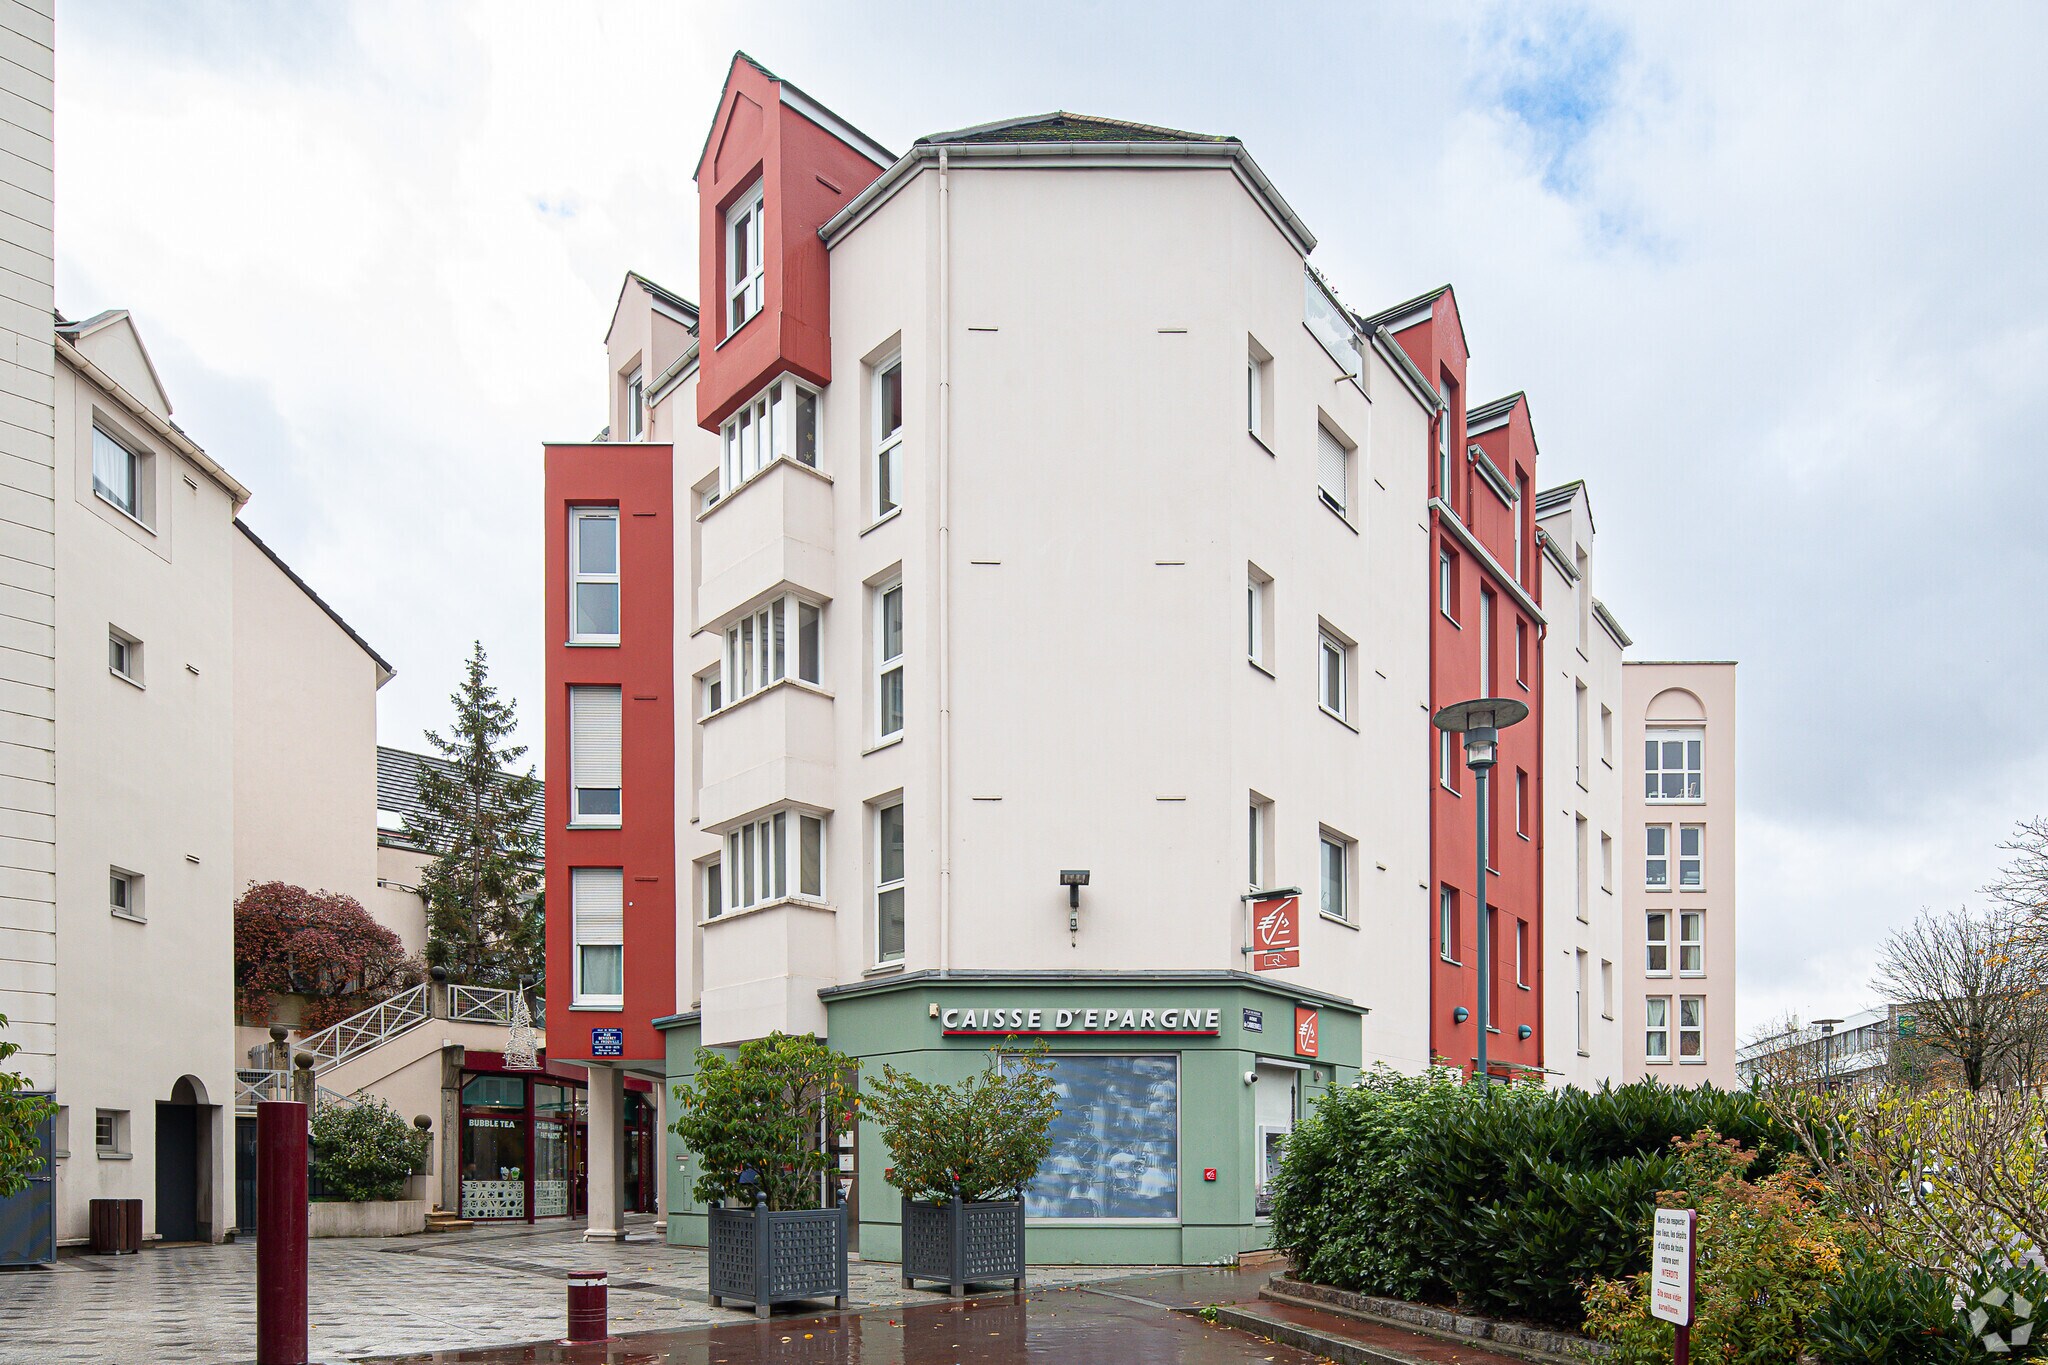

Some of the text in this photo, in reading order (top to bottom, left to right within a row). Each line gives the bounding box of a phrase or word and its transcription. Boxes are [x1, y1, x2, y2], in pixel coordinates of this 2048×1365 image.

[943, 1008, 1219, 1028] CAISSE D'EPARGNE
[469, 1119, 515, 1128] BUBBLE TEA
